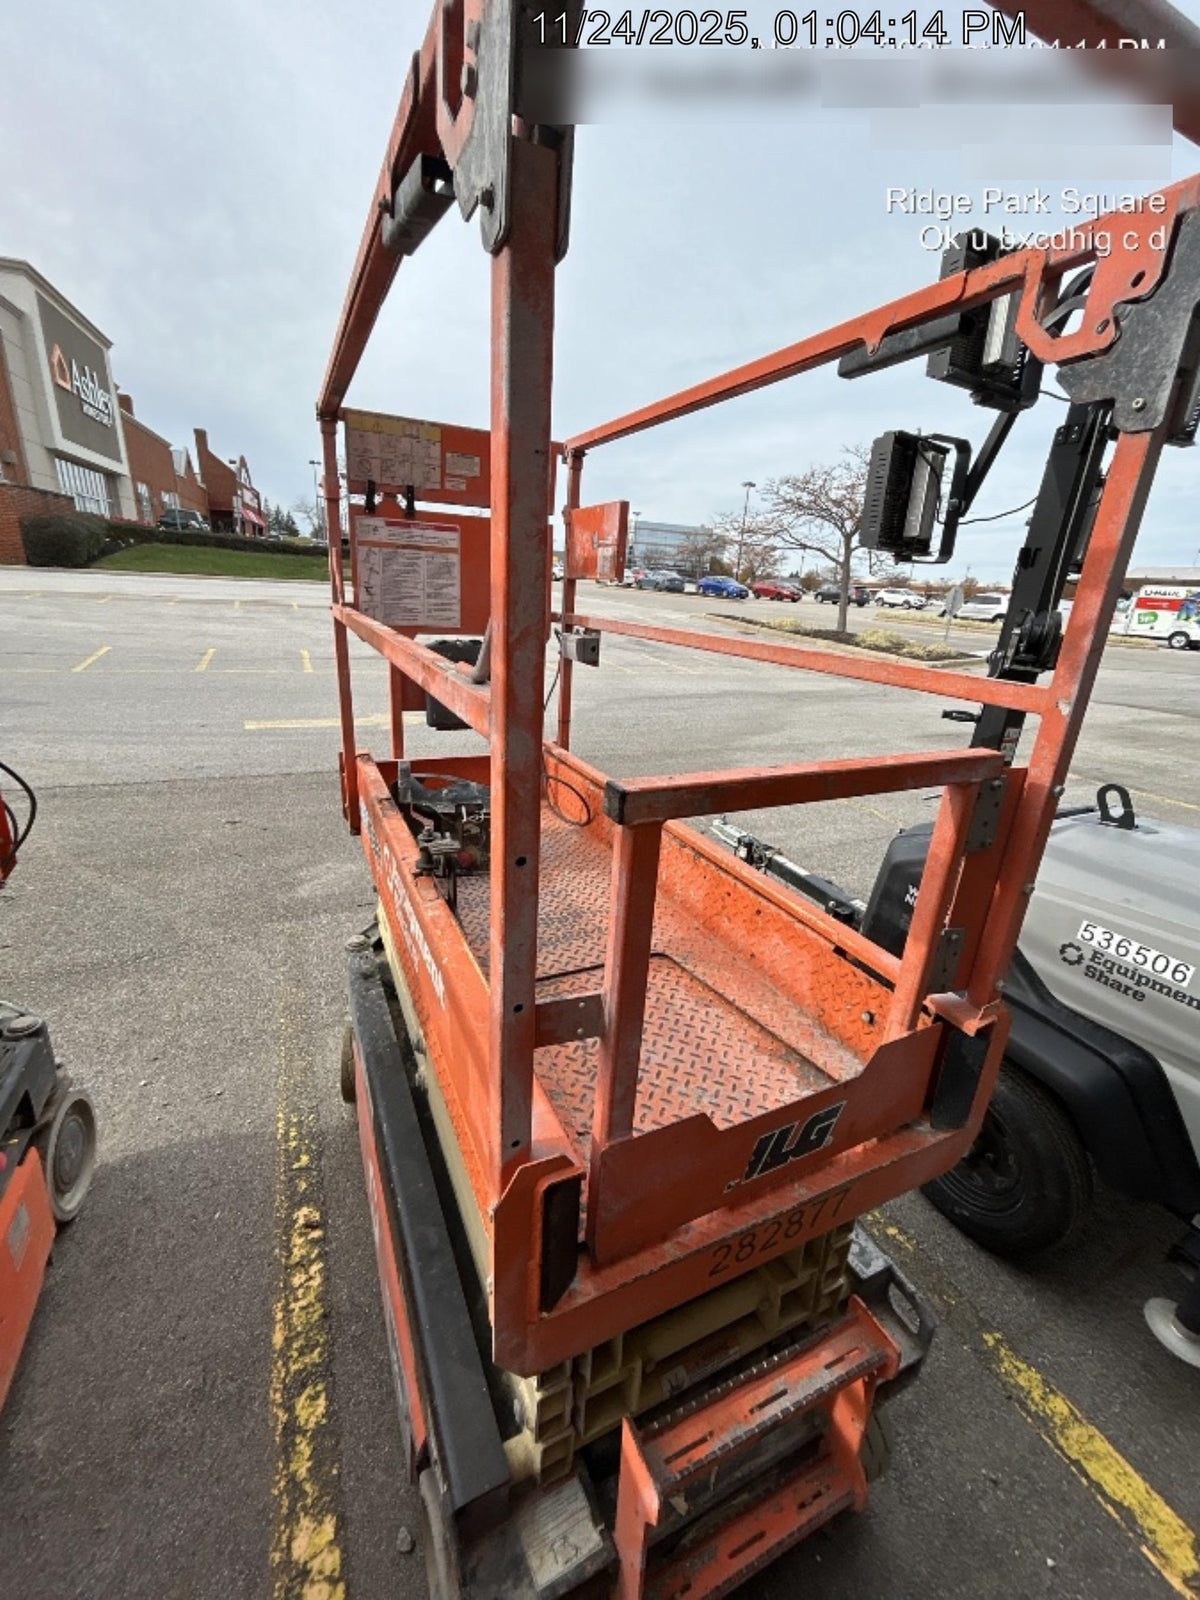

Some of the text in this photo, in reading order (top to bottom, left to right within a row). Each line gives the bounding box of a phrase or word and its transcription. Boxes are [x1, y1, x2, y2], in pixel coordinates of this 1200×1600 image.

[72, 359, 113, 423] Ashley
[1080, 923, 1190, 984] 536506
[1084, 964, 1146, 1002] Share
[1089, 949, 1200, 1011] Equipmen
[724, 1100, 848, 1194] JLG
[708, 1188, 850, 1277] 282877
